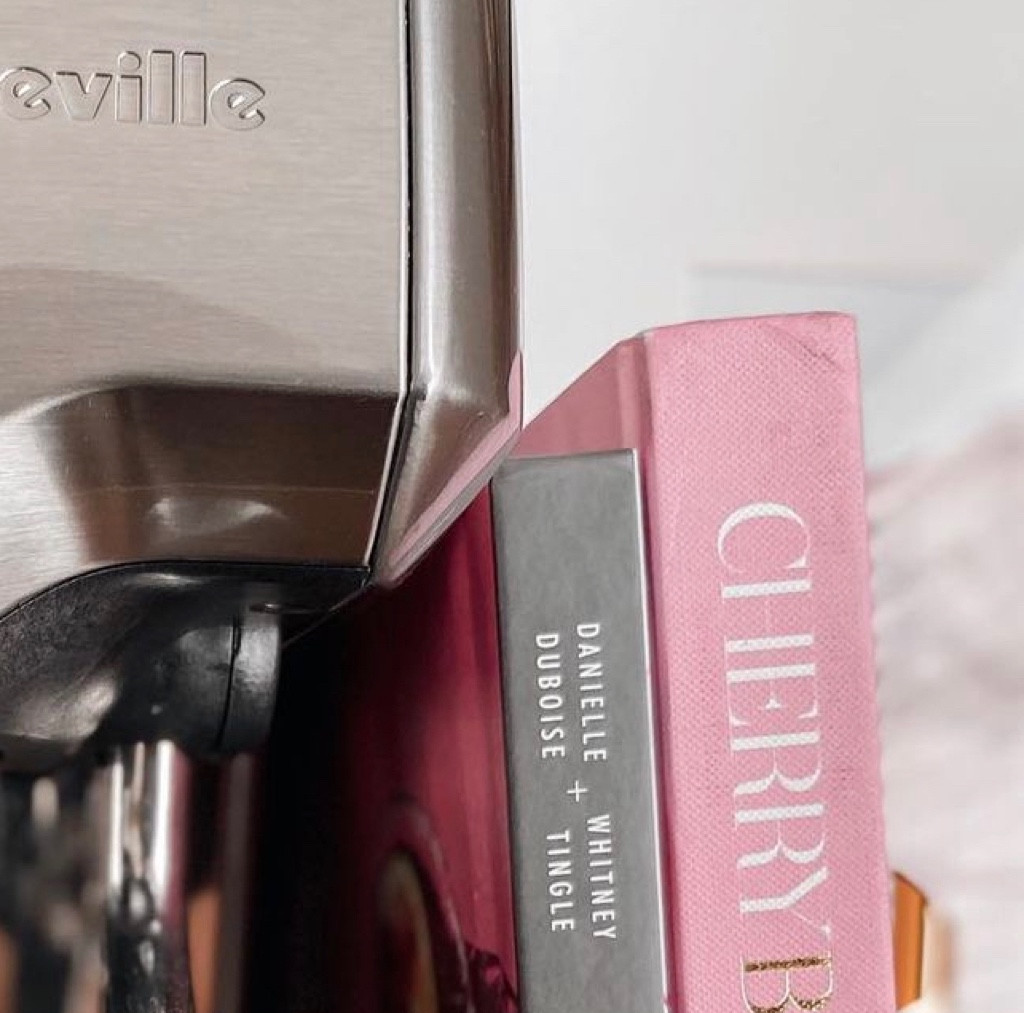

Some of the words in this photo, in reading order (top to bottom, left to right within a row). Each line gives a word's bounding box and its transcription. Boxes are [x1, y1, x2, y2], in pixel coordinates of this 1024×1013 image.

[535, 632, 566, 759] DUBOISE
[576, 622, 607, 763] DANIELLE
[717, 503, 831, 942] CHERRY
[546, 830, 575, 932] TINGLE
[587, 814, 617, 939] WHITNEY
